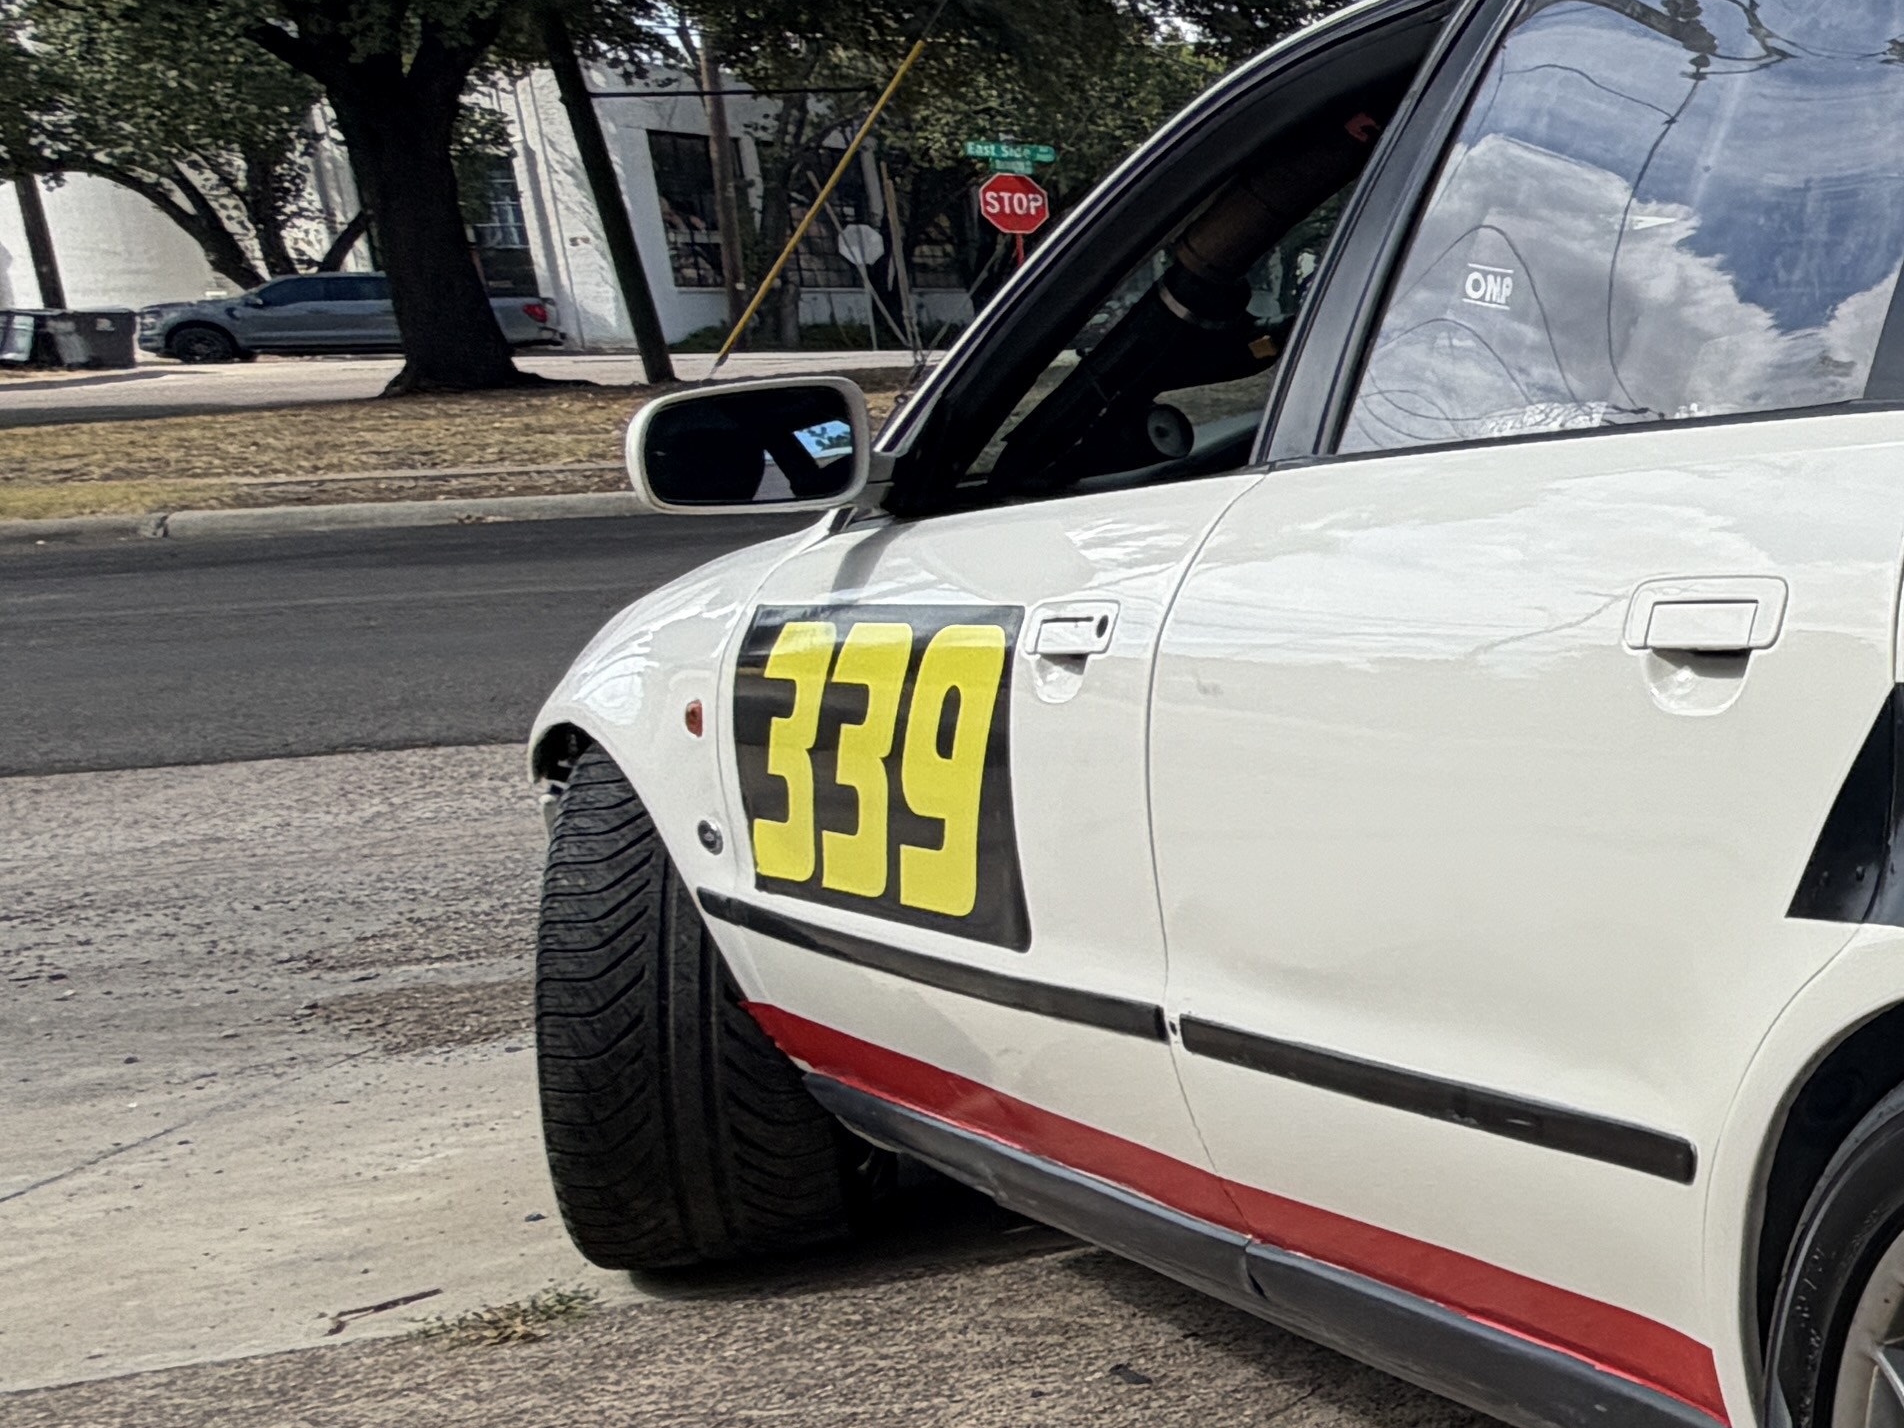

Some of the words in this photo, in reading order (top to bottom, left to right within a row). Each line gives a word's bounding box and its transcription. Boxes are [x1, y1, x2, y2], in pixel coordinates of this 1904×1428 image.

[966, 141, 996, 157] East
[1001, 145, 1031, 158] Side
[985, 191, 1043, 215] STOP
[1464, 271, 1513, 304] OMP
[753, 621, 1006, 917] 339
